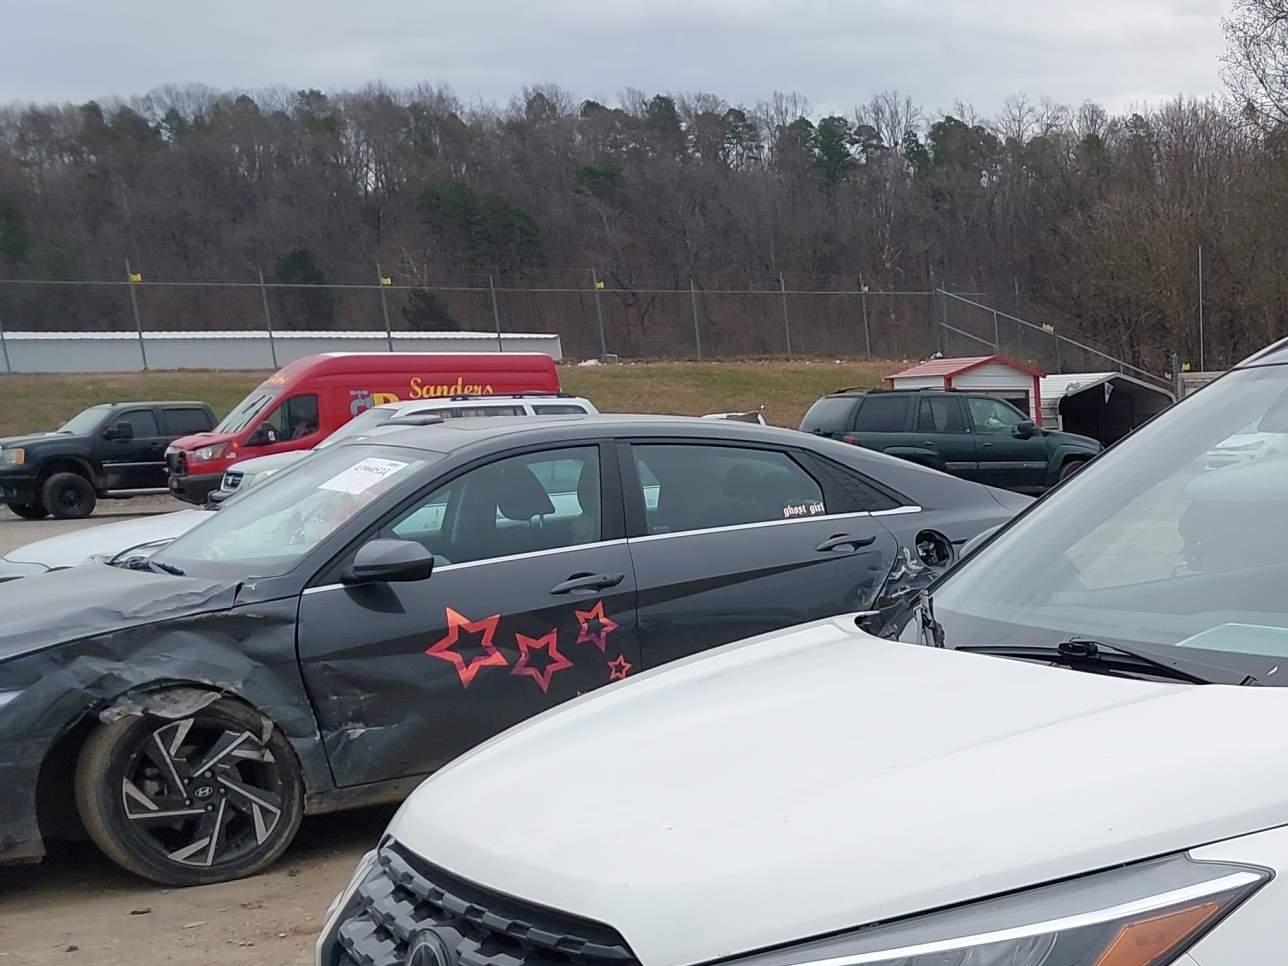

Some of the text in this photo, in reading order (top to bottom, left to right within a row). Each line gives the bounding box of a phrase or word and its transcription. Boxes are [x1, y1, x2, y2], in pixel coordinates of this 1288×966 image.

[409, 376, 494, 399] Sanders
[783, 501, 825, 519] ghost girl
